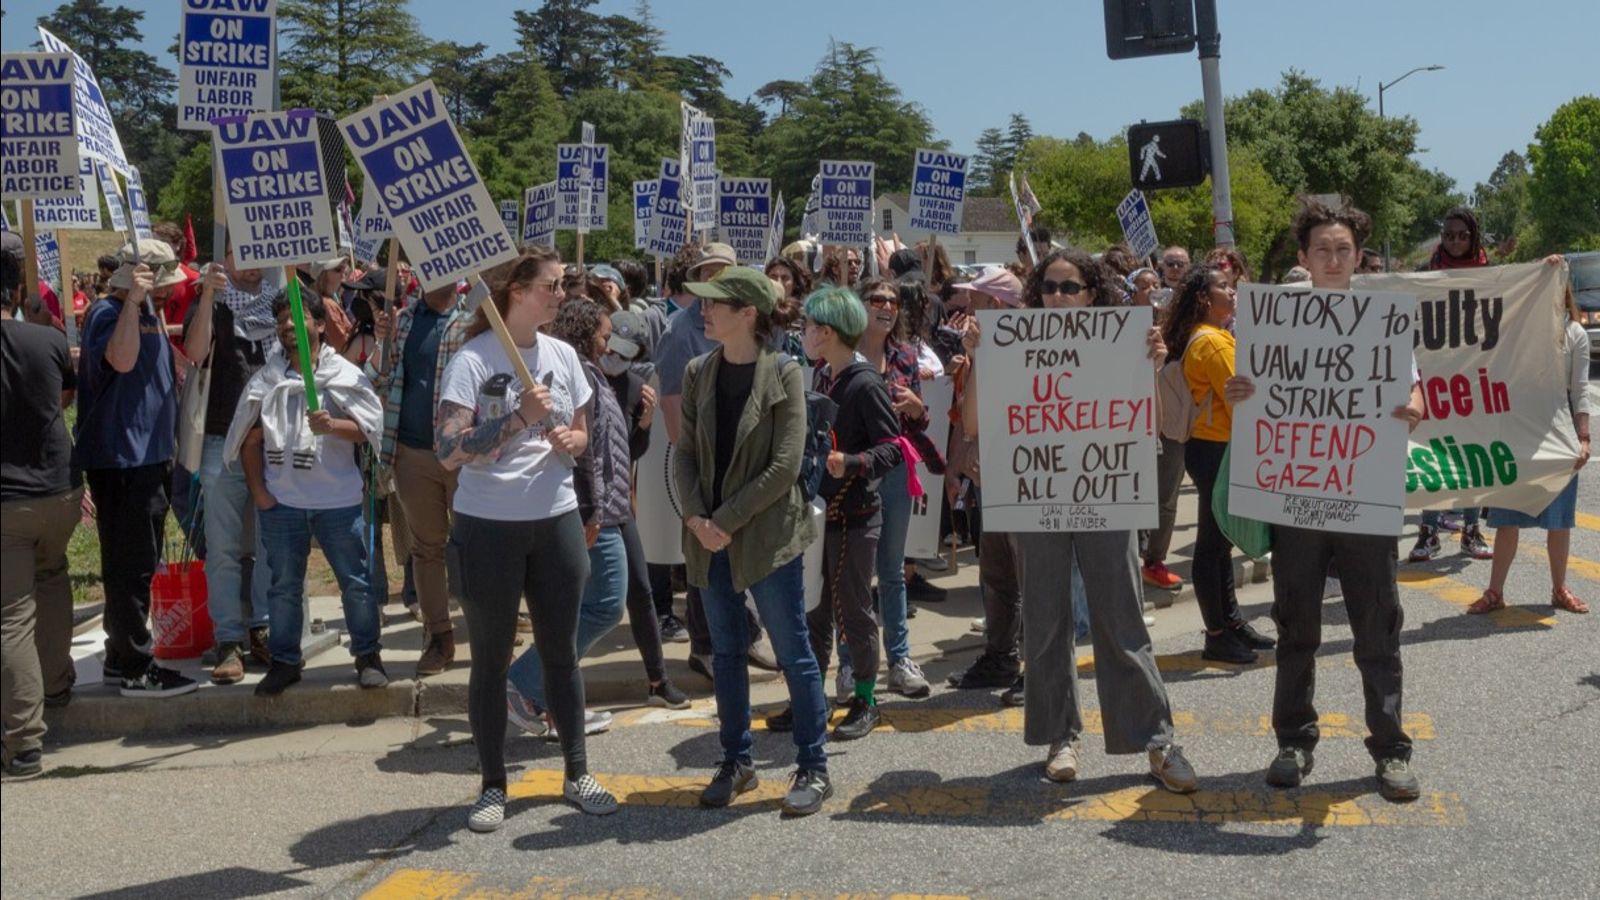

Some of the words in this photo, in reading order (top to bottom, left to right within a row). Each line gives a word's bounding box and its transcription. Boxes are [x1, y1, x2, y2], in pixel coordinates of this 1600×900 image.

[210, 18, 243, 40] ON
[186, 40, 268, 65] STRIKE
[1, 58, 69, 80] AW
[195, 70, 257, 88] UNFAIR
[1, 88, 40, 110] ON
[197, 88, 253, 106] LABOR
[1, 111, 70, 134] RIKE
[184, 106, 267, 122] PRACTI
[345, 88, 437, 149] UAW
[218, 118, 311, 144] UAW
[1, 140, 61, 157] NFAIR
[393, 136, 433, 172] ON
[3, 159, 58, 175] ABOR
[252, 148, 288, 172] ON
[919, 152, 966, 169] UAW
[823, 163, 872, 177] UAW
[931, 170, 950, 184] ON
[3, 175, 75, 193] ACTICE
[230, 171, 320, 199] STRIKE
[383, 155, 472, 210] STRIKE
[560, 178, 604, 191] STRKE
[636, 182, 657, 193] UA
[720, 181, 769, 194] UAW
[836, 181, 856, 194] ON
[915, 182, 962, 200] STRIKE
[528, 185, 556, 205] UAW
[822, 194, 870, 208] STRIKE
[244, 200, 314, 222] UNFAIR
[408, 193, 477, 234] UNFAIR
[535, 204, 548, 220] ON
[565, 205, 597, 215] LAR
[735, 199, 754, 211] ON
[919, 198, 955, 212] UNFAIR
[35, 208, 97, 222] RACTICE
[558, 215, 604, 225] PRACE
[721, 212, 768, 226] STRIKE
[827, 211, 864, 221] UNFAIR
[919, 208, 952, 222] LABOR
[251, 220, 313, 241] LABOR
[525, 217, 554, 238] STRIKE
[728, 228, 763, 238] UNFAIR
[828, 222, 862, 232] LABOR
[910, 218, 959, 233] PRACTICE
[422, 216, 485, 255] LABOR
[730, 239, 762, 249] LABOR
[821, 231, 868, 243] PRACTICE
[239, 236, 331, 261] PRACTICE
[419, 232, 510, 282] PRACTICE
[736, 250, 767, 260] ACTIC
[1250, 290, 1372, 337] VICTORY
[1381, 303, 1410, 338] to
[993, 310, 1131, 347] SOLIDARITY
[1025, 349, 1080, 369] FROM
[1250, 343, 1308, 382] UAW
[1032, 371, 1073, 403] UC
[1478, 368, 1511, 414] in
[1007, 396, 1153, 436] BERKELEY!
[1255, 418, 1376, 461] DEFEND
[1012, 444, 1067, 475] ONE
[1081, 441, 1138, 472] OUT
[1256, 459, 1355, 495] GAZA!
[1017, 476, 1058, 503] ALL
[1042, 505, 1063, 517] UAW
[1069, 505, 1098, 516] LOCAL
[1066, 517, 1107, 529] MEMBER
[1294, 516, 1326, 528] YOUTH
